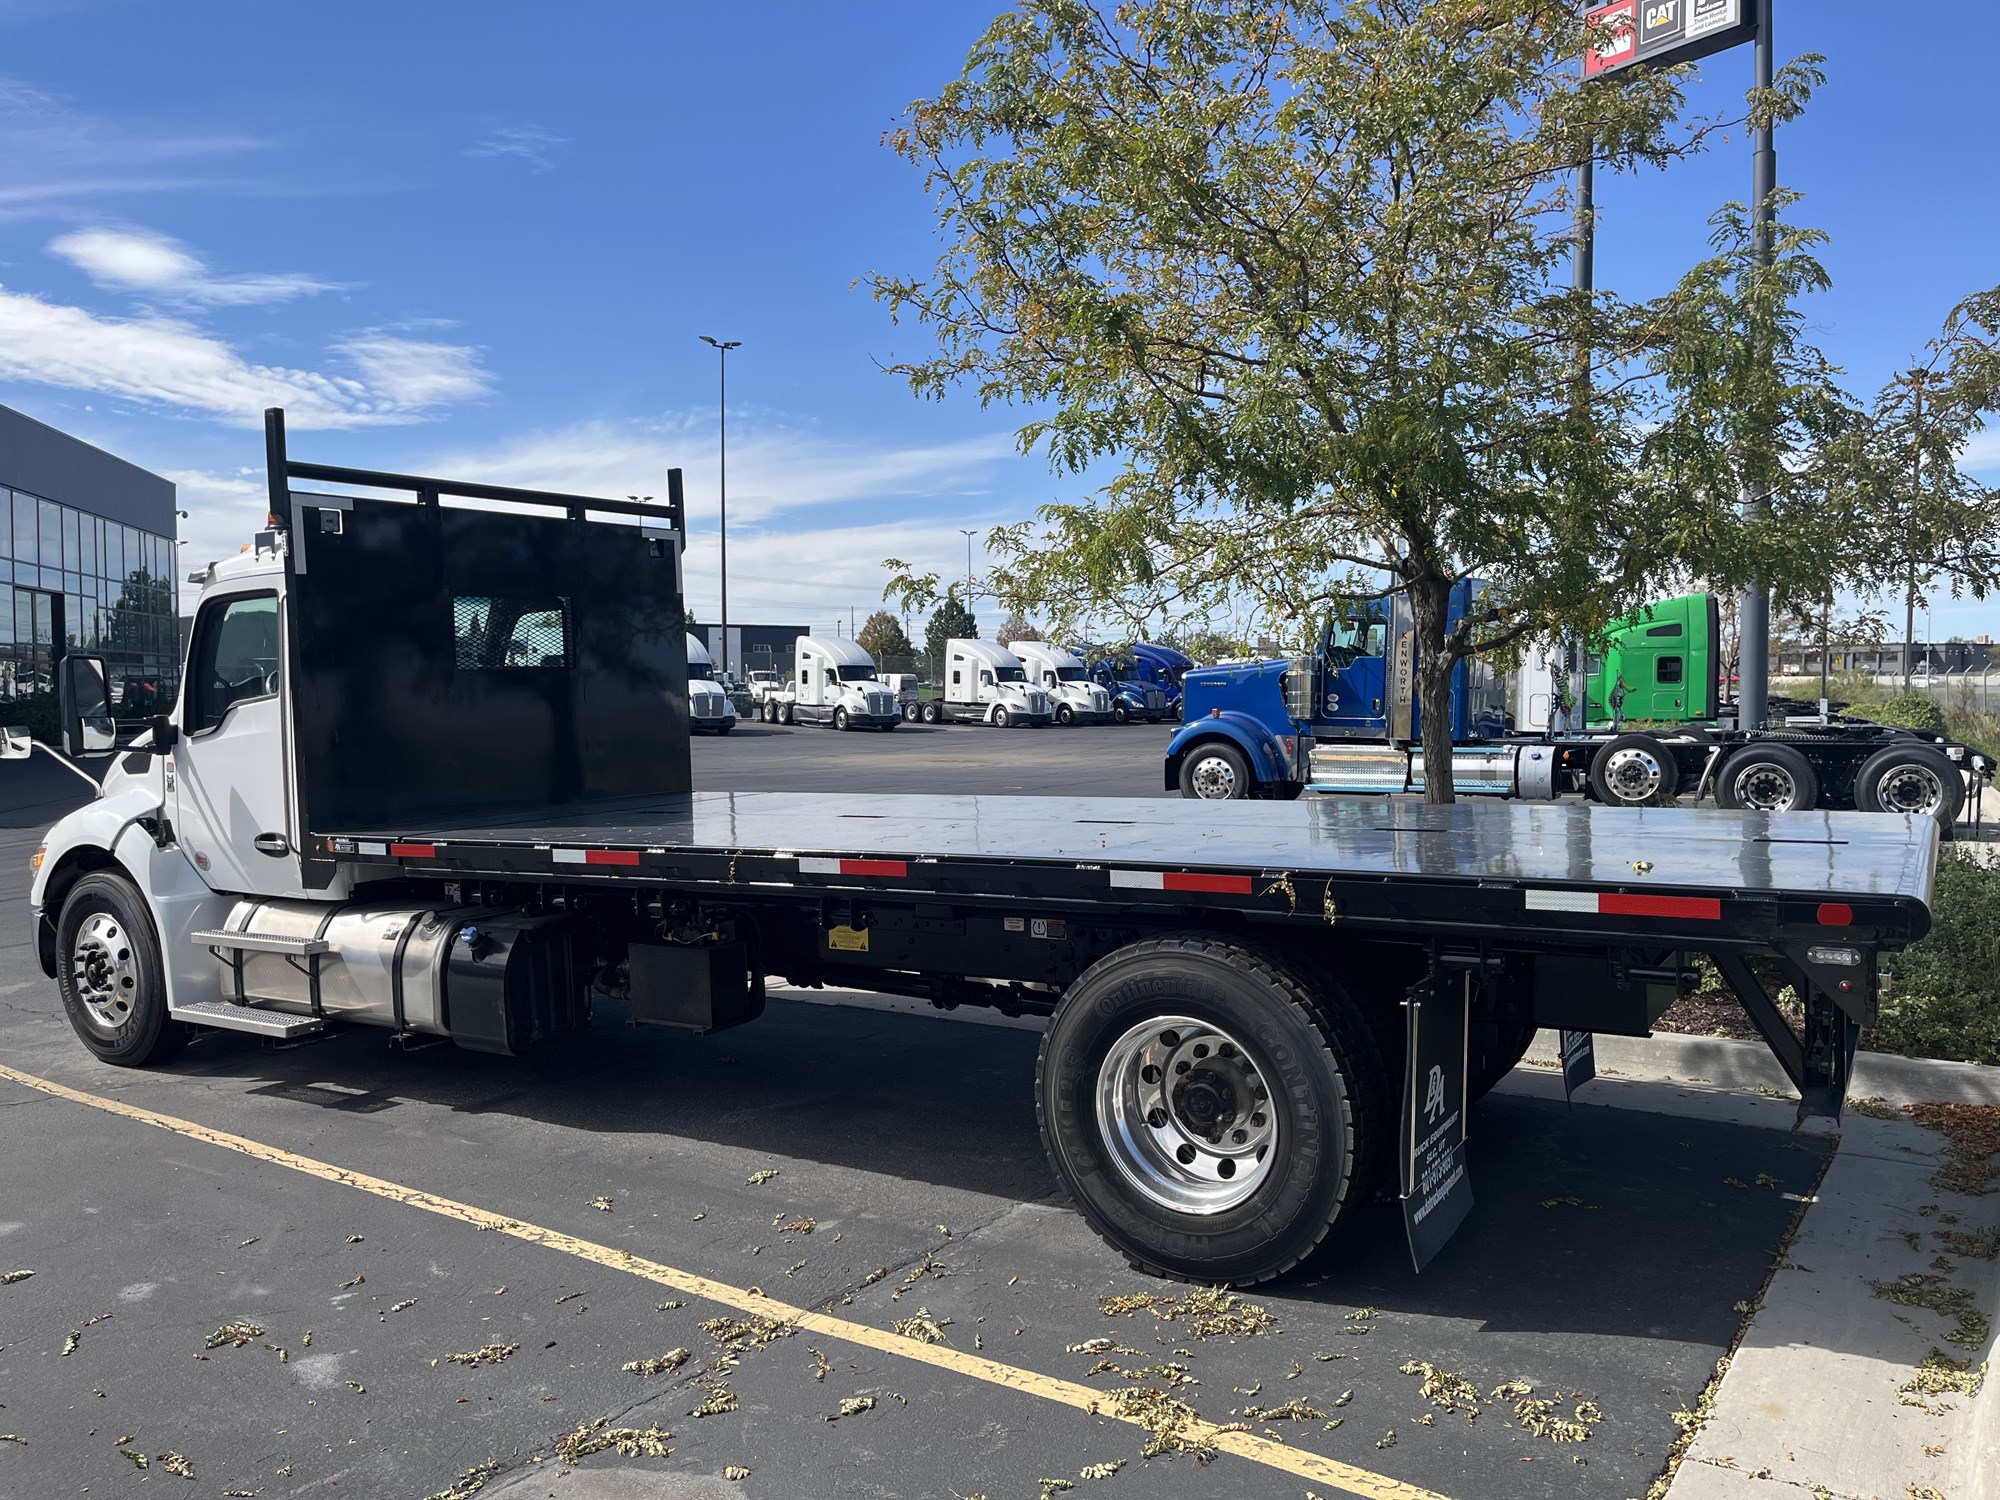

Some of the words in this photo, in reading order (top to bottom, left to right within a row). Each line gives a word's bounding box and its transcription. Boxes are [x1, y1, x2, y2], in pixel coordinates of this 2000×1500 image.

[1646, 0, 1676, 29] CAT
[1694, 15, 1709, 24] Truck
[1709, 8, 1728, 20] Rental
[1704, 15, 1727, 28] Leasing
[1400, 632, 1408, 703] KENWORTH
[1095, 975, 1209, 1016] Continental
[1414, 1137, 1430, 1158] RUCK
[1430, 1110, 1459, 1145] EQUIPMENT
[1438, 1138, 1447, 1152] UT
